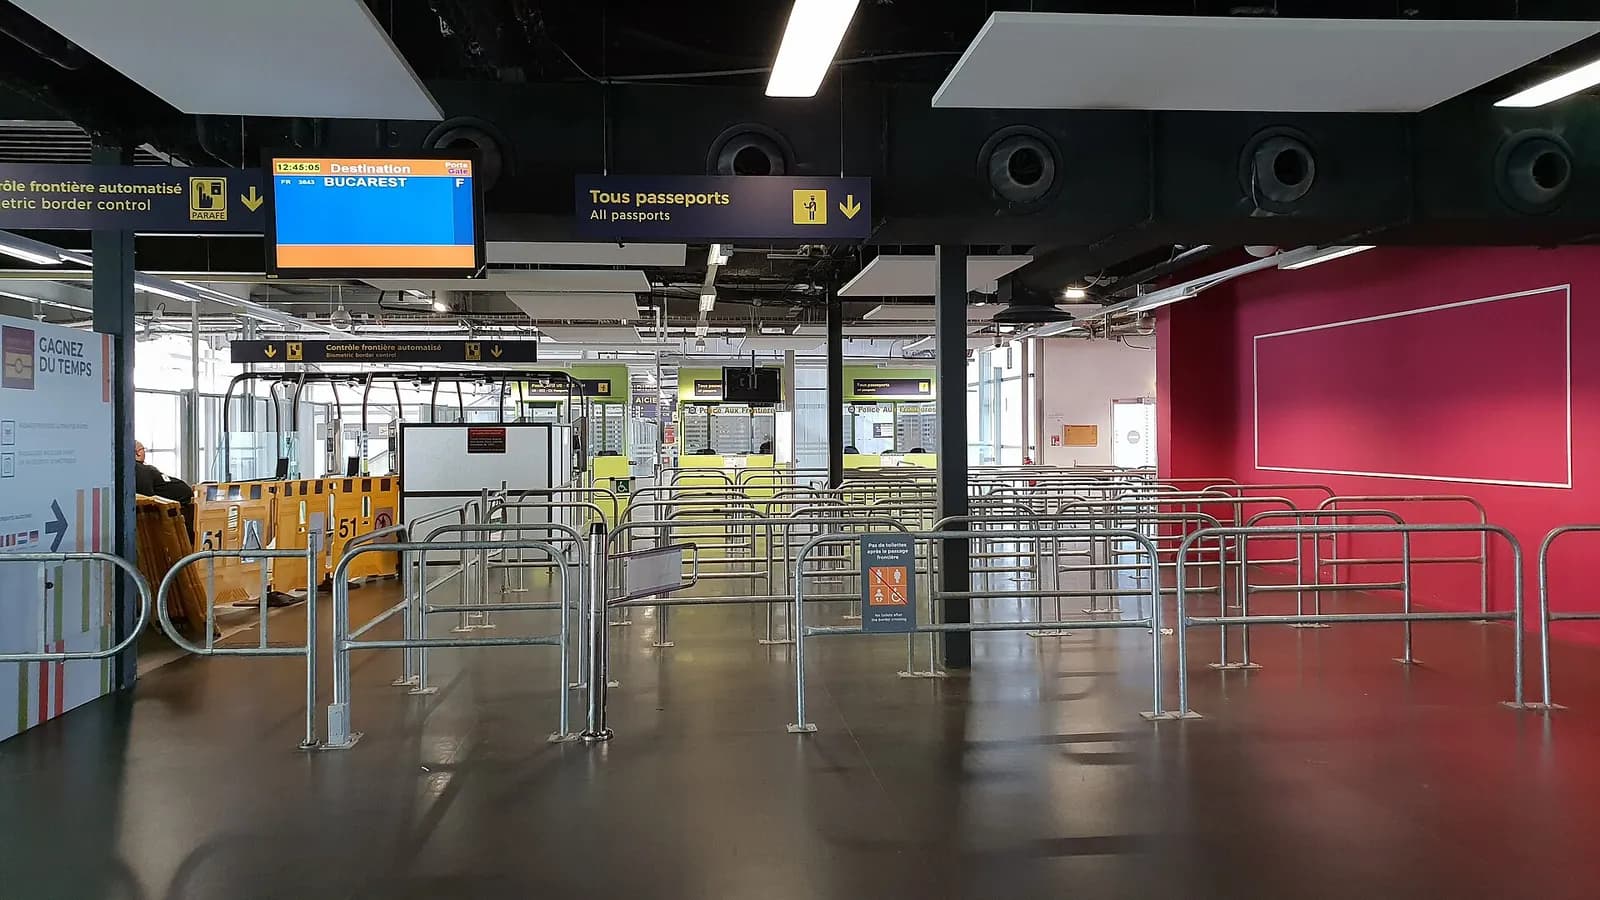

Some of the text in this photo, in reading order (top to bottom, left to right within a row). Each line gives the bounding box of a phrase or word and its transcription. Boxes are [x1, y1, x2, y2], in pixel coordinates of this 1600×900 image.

[278, 163, 320, 171] 12:45:05
[331, 163, 411, 174] Destination
[30, 180, 95, 193] frontière
[98, 182, 183, 195] automatisé
[324, 177, 407, 188] BUCAREST
[455, 178, 465, 188] F
[41, 197, 92, 210] border
[97, 199, 152, 211] control
[589, 189, 731, 208] Tous passeports
[192, 211, 225, 220] PARAFE
[590, 209, 671, 223] All passports
[39, 336, 84, 358] GAGNEZ
[39, 355, 92, 377] DU TEMPS
[339, 517, 357, 538] 51
[202, 529, 223, 551] 51
